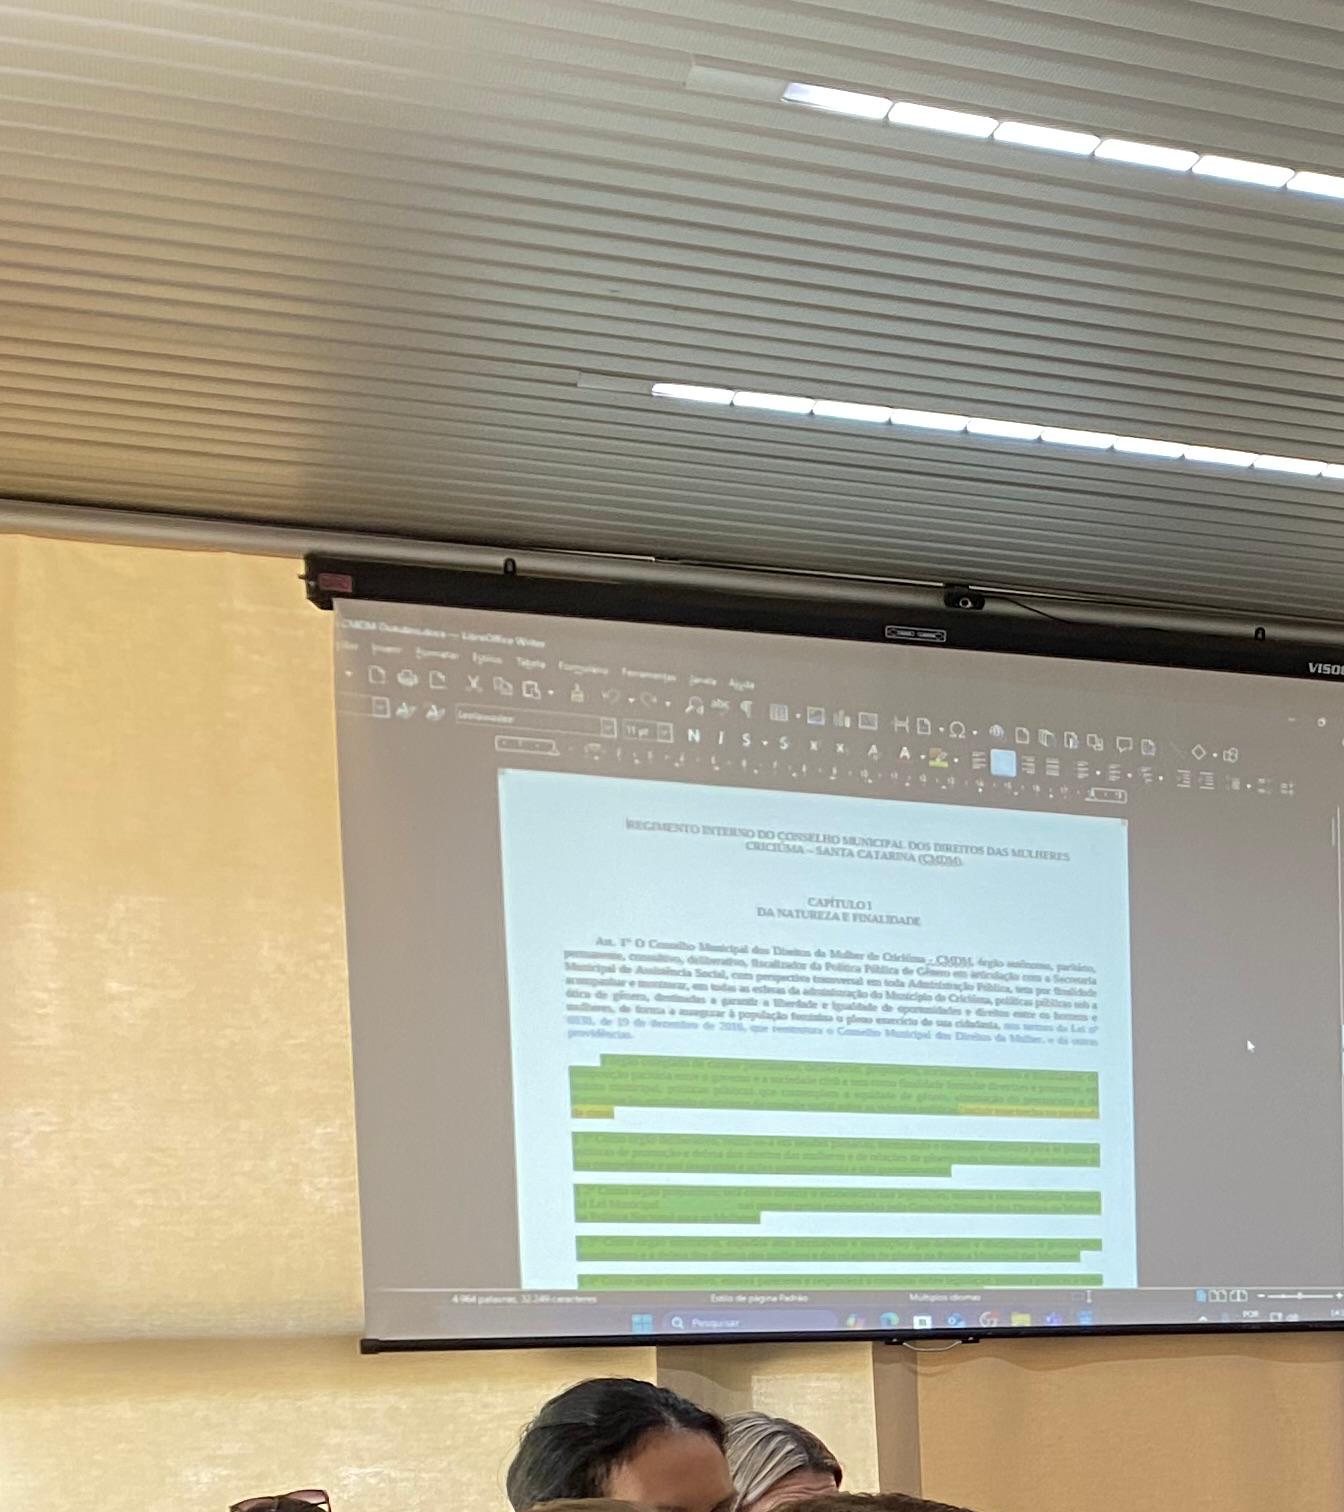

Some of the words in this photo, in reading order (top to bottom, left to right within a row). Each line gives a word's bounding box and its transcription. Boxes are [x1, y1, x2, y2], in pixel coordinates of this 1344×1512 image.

[757, 829, 774, 841] DO
[777, 830, 840, 846] CONSELHO
[908, 841, 931, 852] DOS
[933, 842, 985, 856] DIREITOS
[987, 846, 1009, 857] DAS
[816, 845, 854, 858] SANTA
[857, 849, 916, 863] CATARINA
[807, 896, 866, 911] CAPÍTULO
[757, 906, 776, 918] DA
[777, 908, 840, 922] NATUREZA
[852, 912, 921, 926] FINALIDADE
